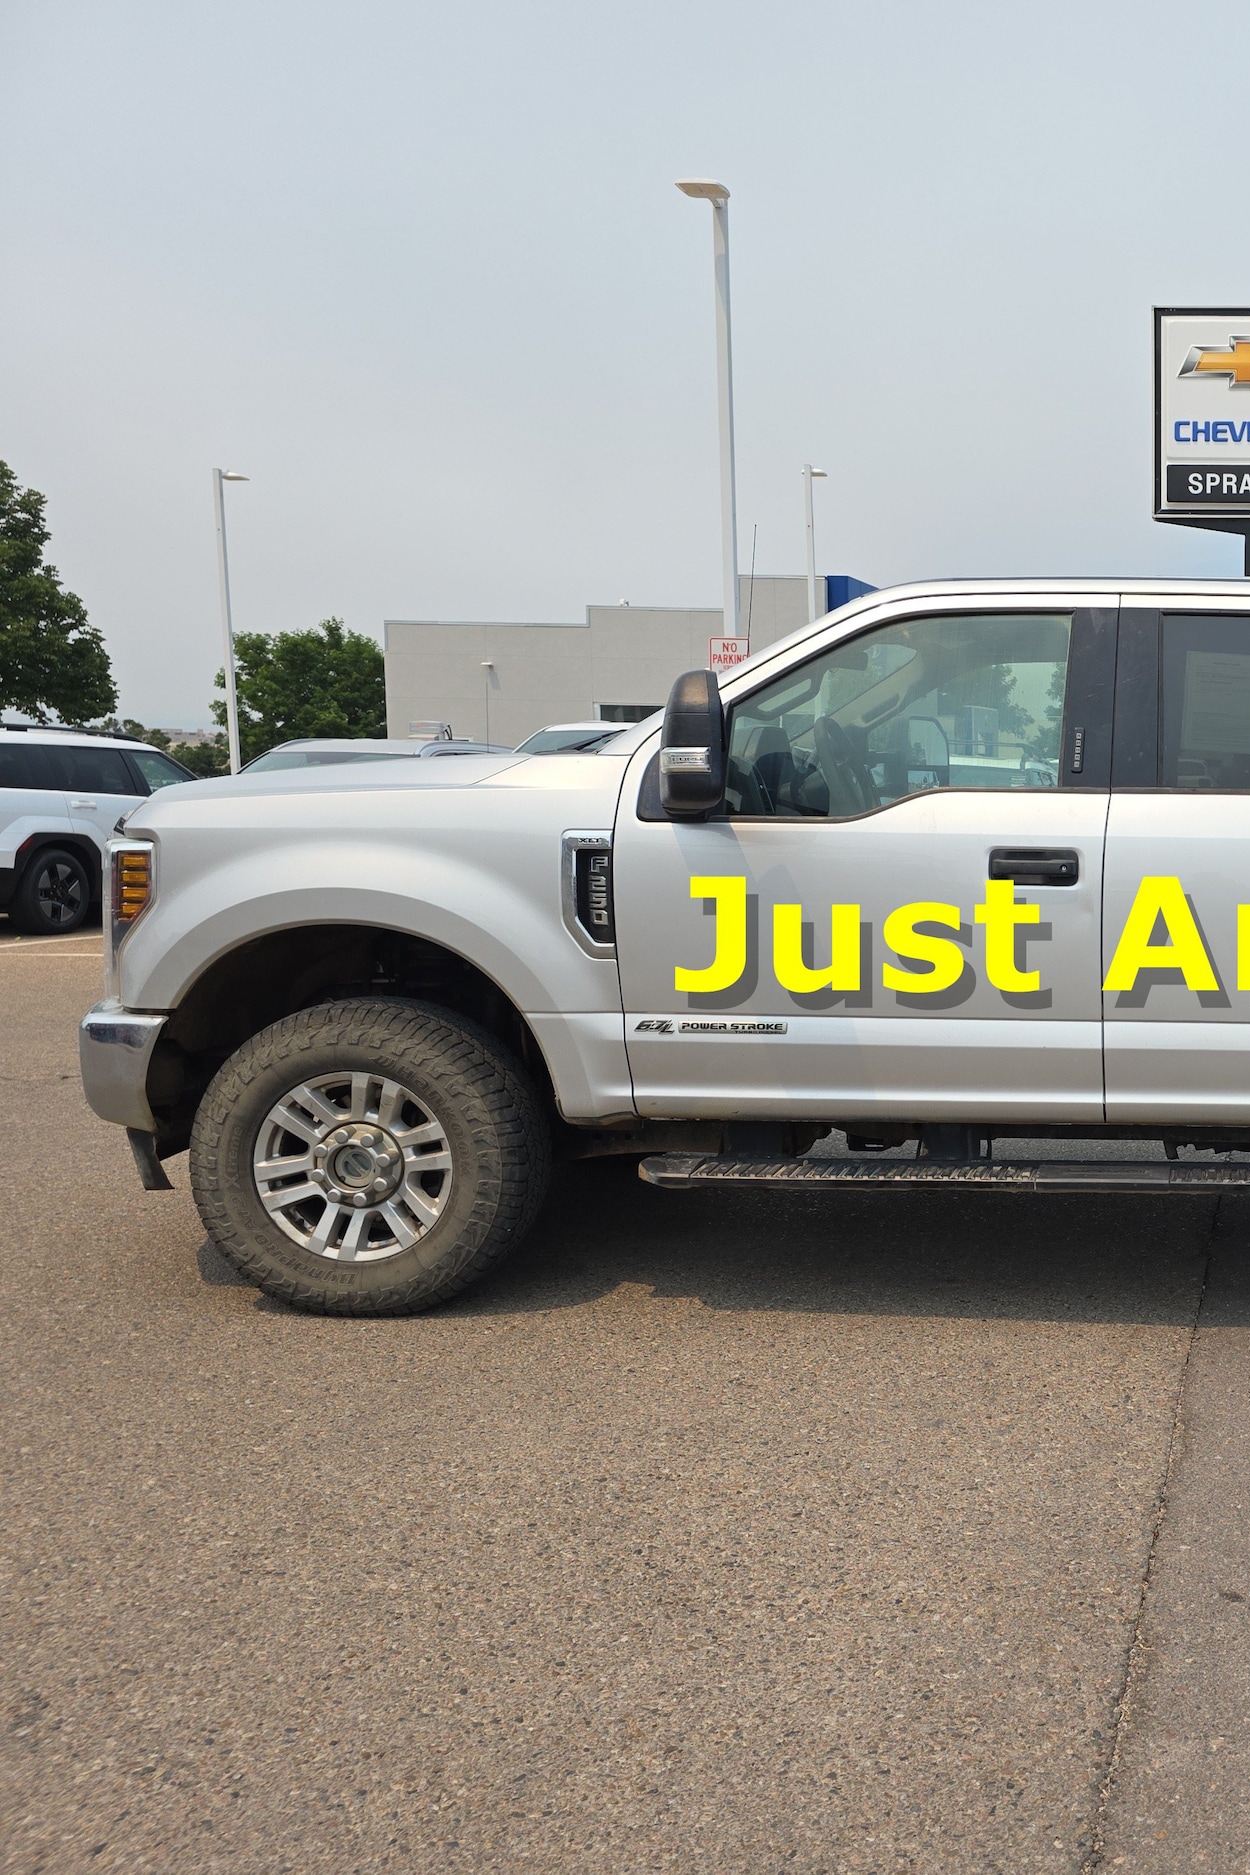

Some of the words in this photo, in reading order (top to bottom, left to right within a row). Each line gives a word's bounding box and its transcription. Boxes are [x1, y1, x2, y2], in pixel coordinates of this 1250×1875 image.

[722, 642, 737, 652] NO
[681, 1022, 727, 1030] POWER
[730, 1022, 783, 1031] STROKE
